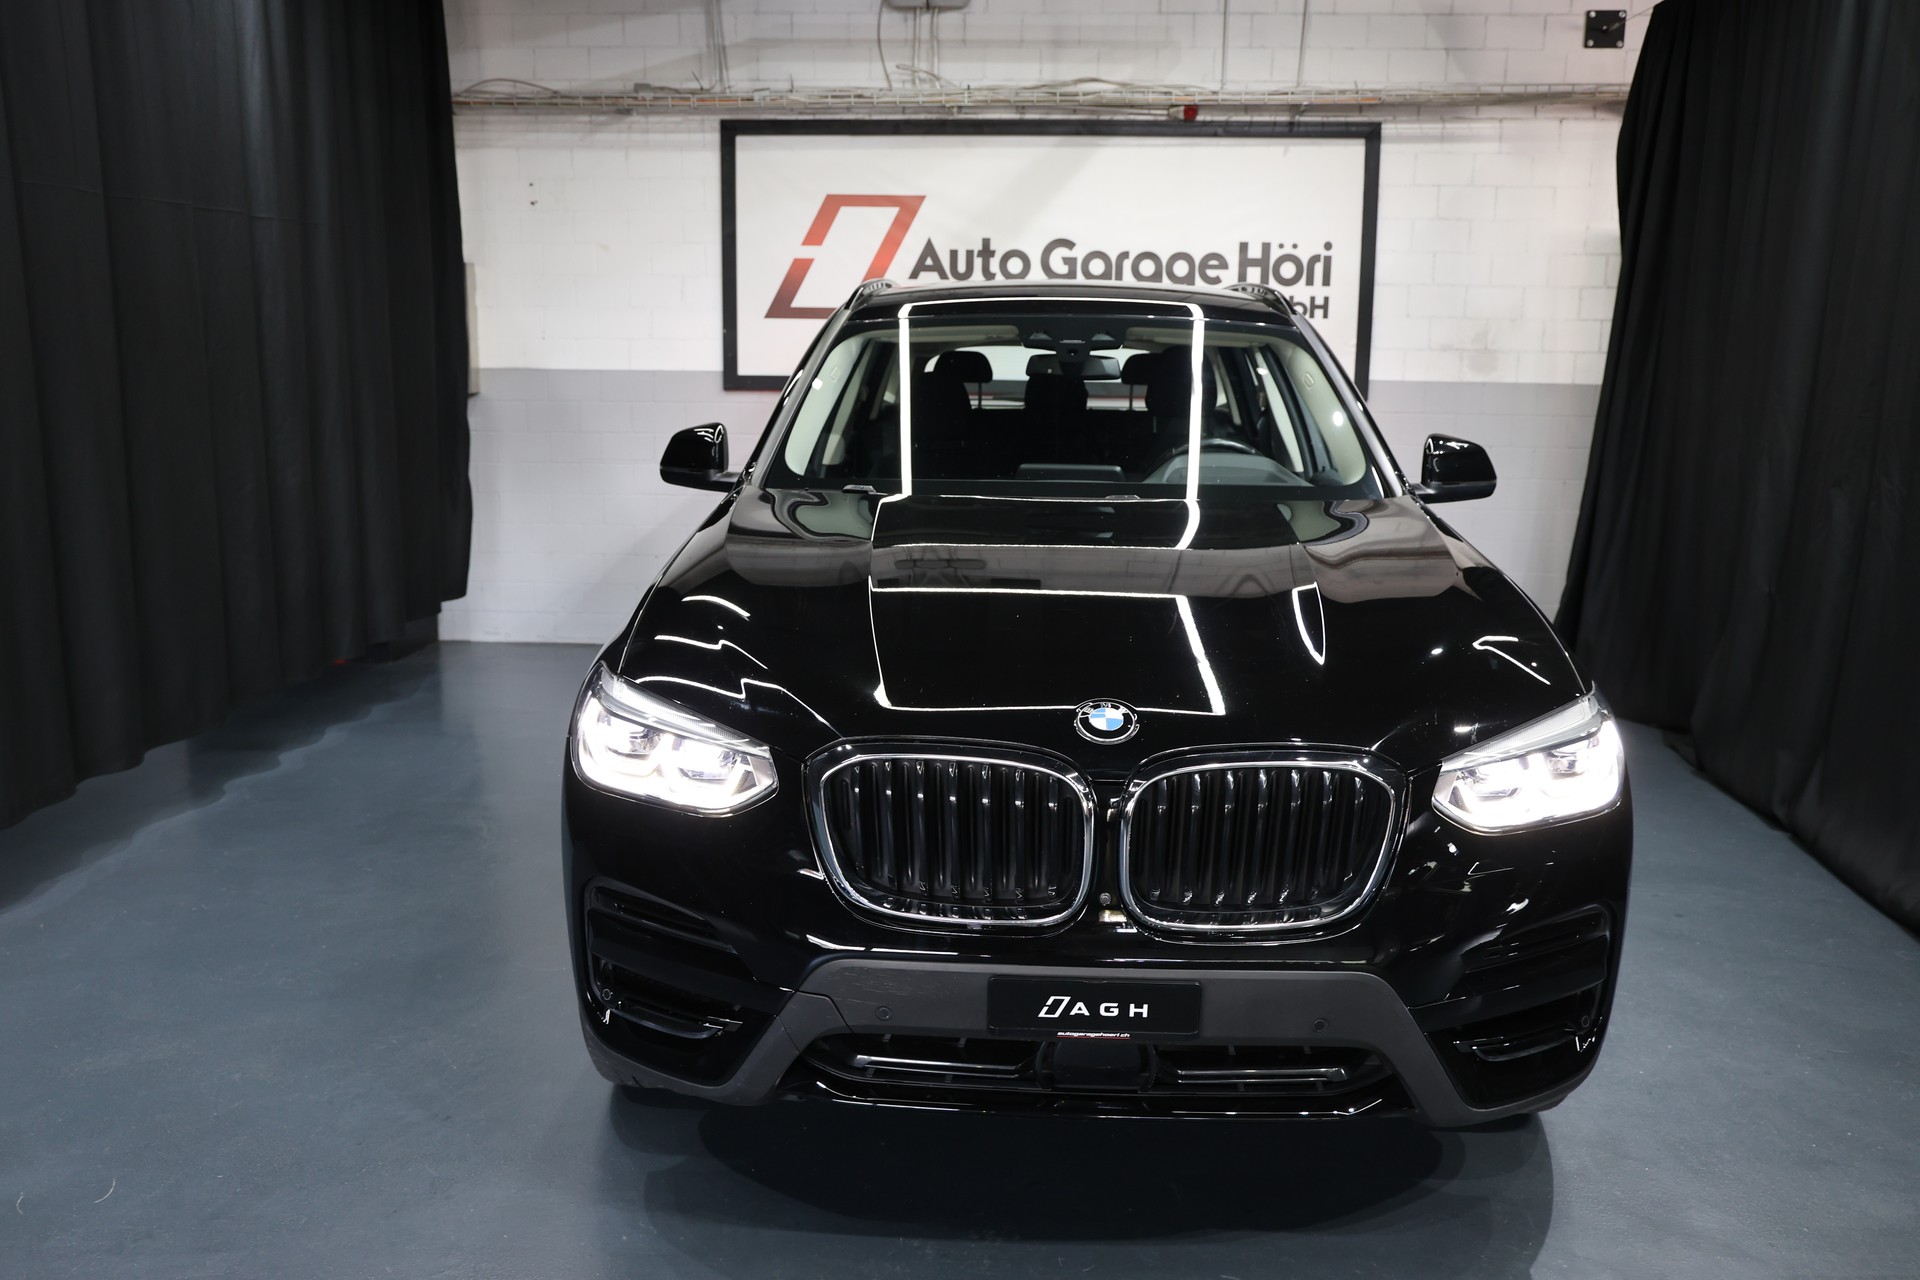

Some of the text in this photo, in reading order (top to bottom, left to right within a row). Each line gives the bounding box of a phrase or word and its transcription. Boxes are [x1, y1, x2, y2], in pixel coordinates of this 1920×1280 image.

[908, 237, 1333, 287] Auto Garage Höri
[1289, 296, 1329, 319] bH
[1069, 1002, 1149, 1018] AGH
